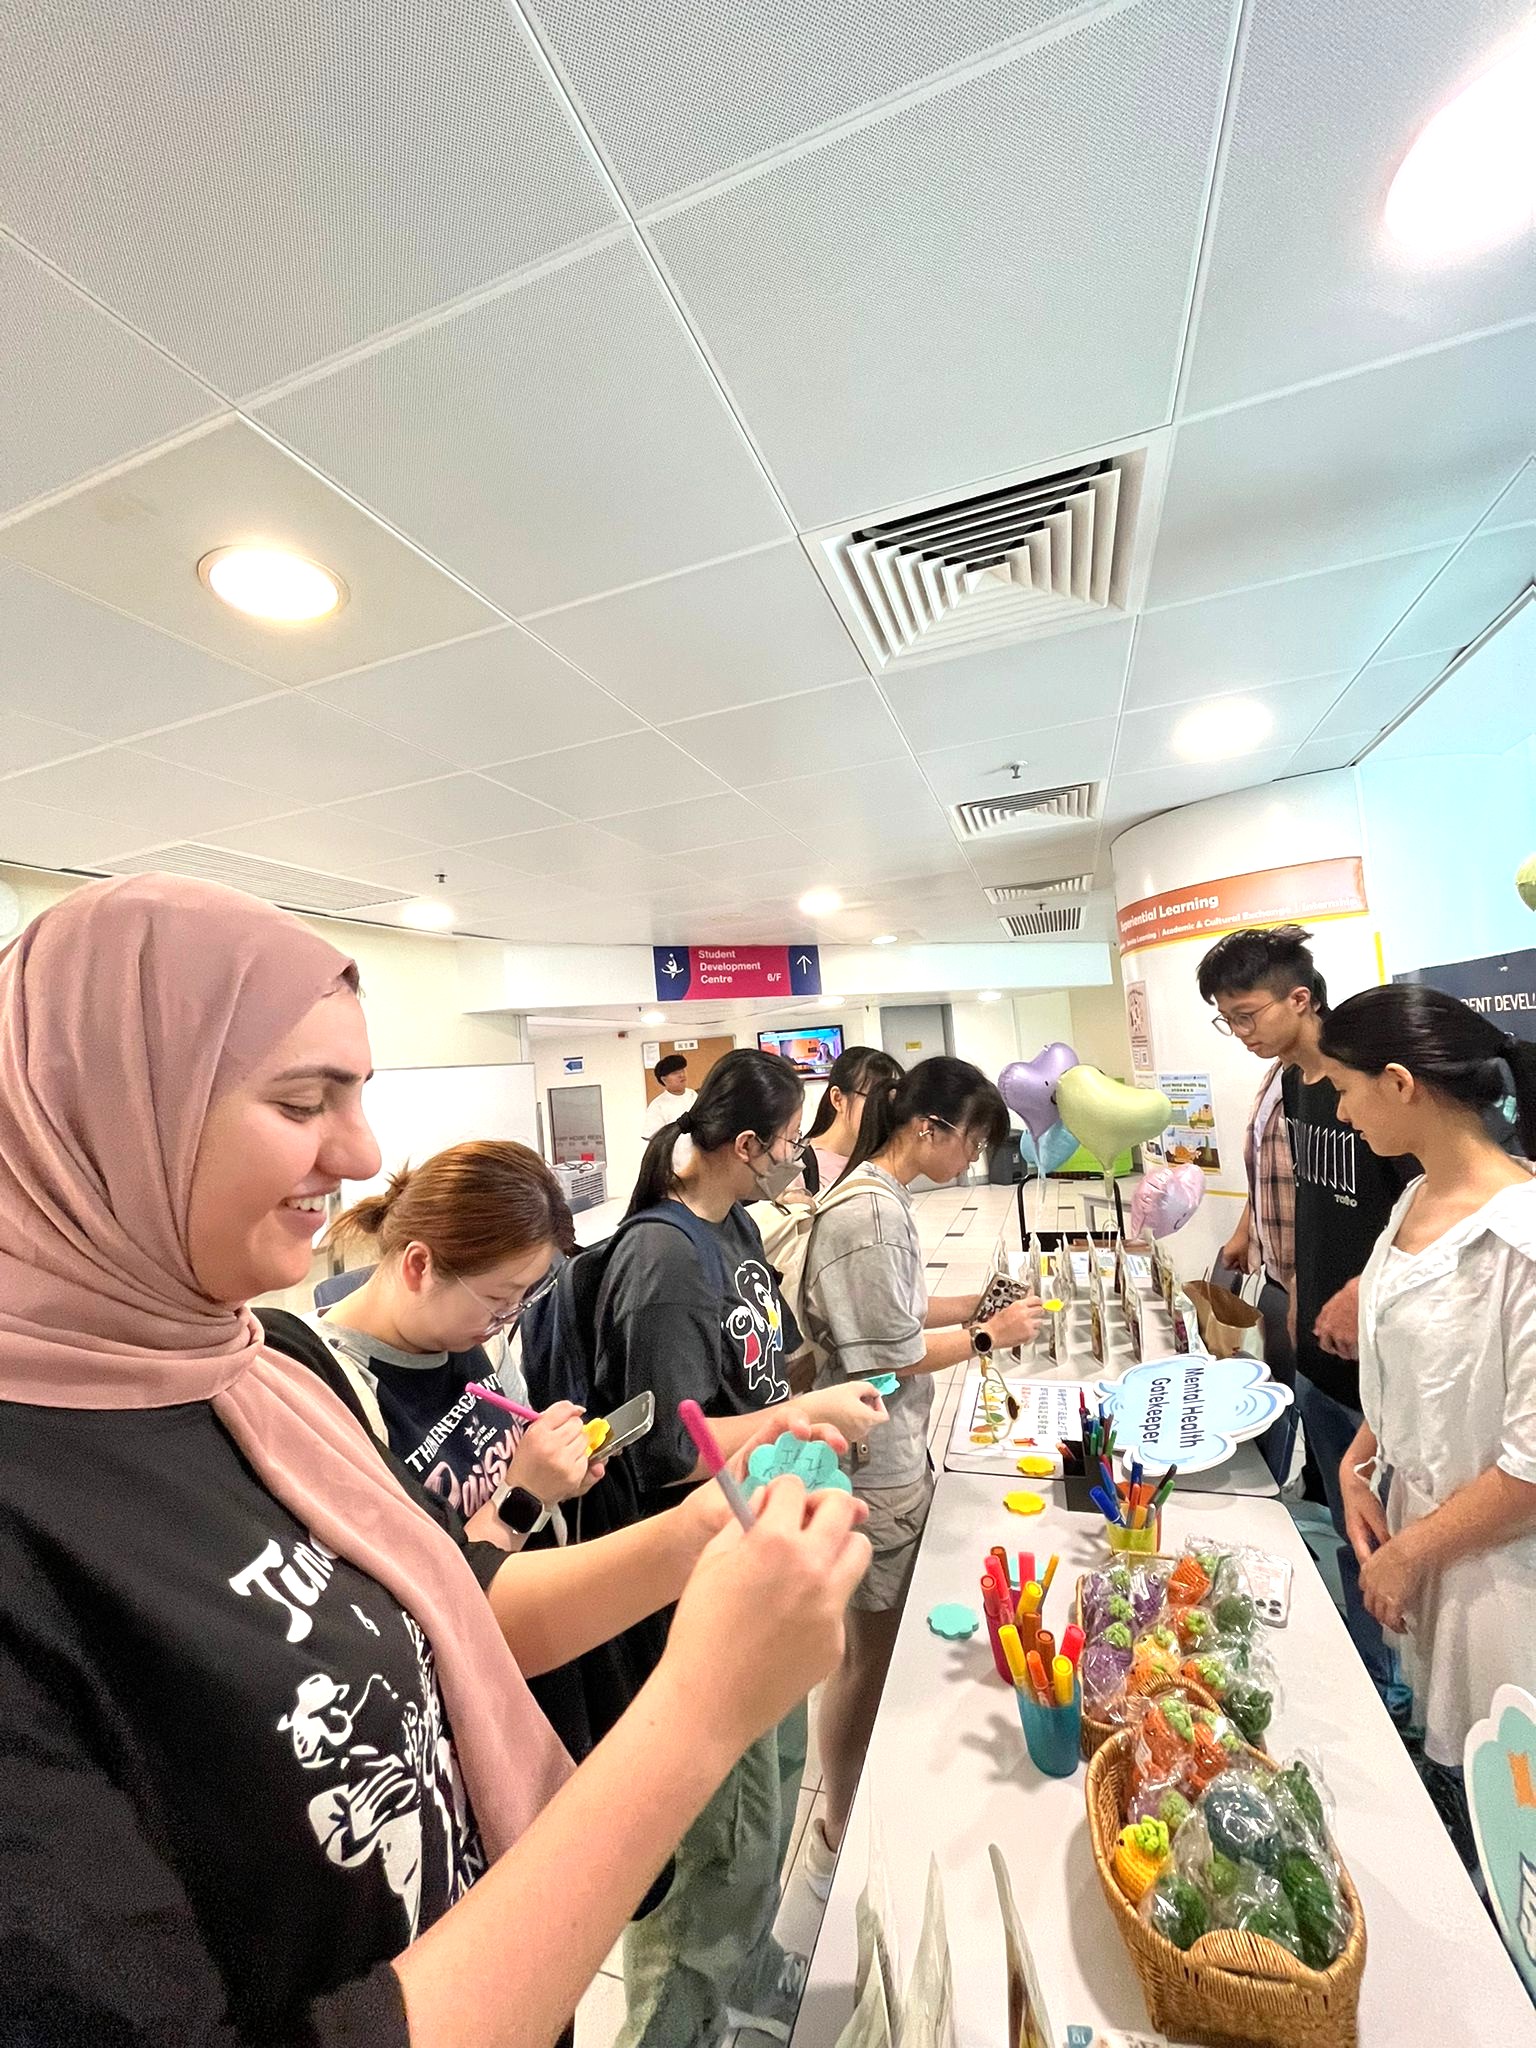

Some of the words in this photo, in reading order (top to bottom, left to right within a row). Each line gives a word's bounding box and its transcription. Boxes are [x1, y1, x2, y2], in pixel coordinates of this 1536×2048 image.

[1159, 896, 1219, 918] Learning
[1162, 922, 1194, 936] Academic
[1195, 920, 1202, 928] &
[1204, 913, 1240, 927] Cultural
[698, 950, 736, 958] Student
[699, 961, 761, 971] Development
[700, 974, 733, 984] Centre
[767, 973, 782, 982] 6/F
[1494, 993, 1536, 1012] DEVEL
[1183, 1367, 1205, 1404] Mental
[1138, 1377, 1171, 1444] Gatekeeper
[1179, 1405, 1205, 1448] Health
